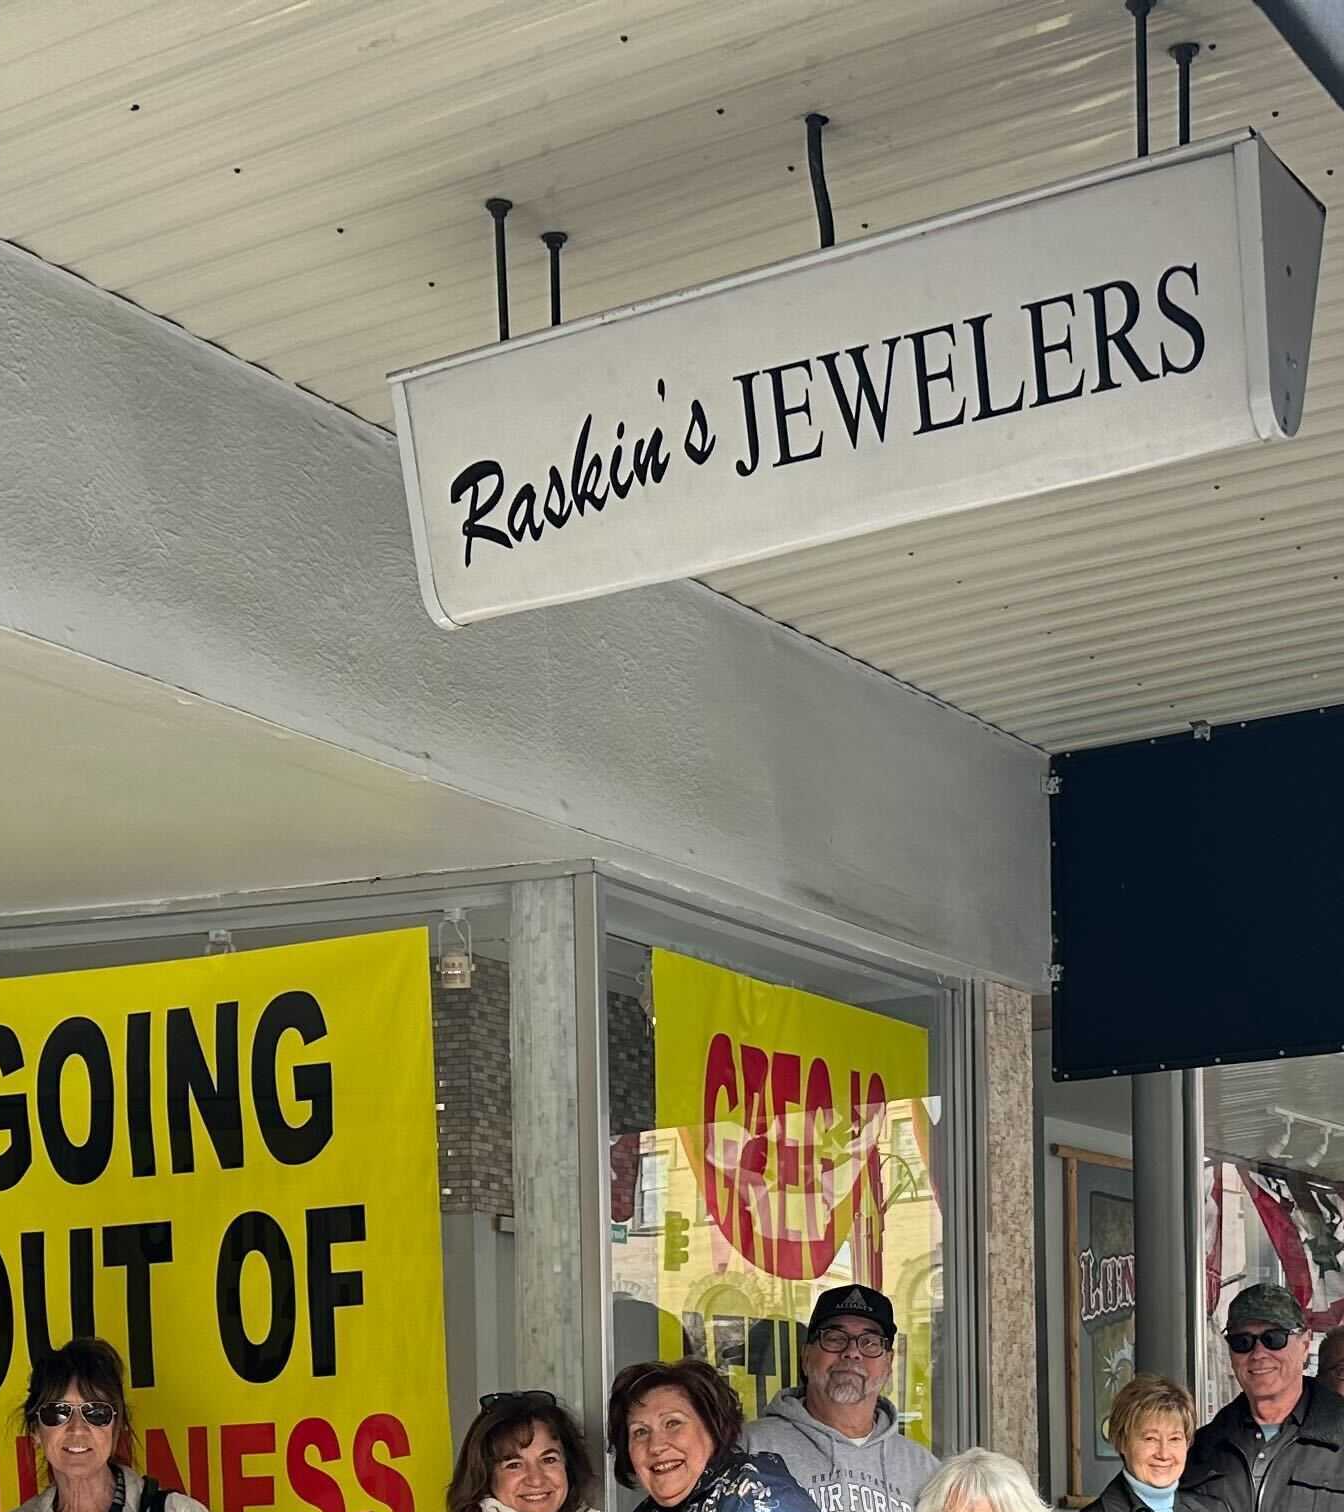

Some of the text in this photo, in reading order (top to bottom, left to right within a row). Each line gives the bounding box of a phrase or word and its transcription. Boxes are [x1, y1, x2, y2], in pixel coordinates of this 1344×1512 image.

[450, 261, 1208, 568] Raskin's JEWELERS
[704, 1032, 835, 1281] GREG
[215, 1203, 367, 1383] OF
[1080, 1248, 1136, 1320] LON
[811, 1469, 854, 1484] UNITD
